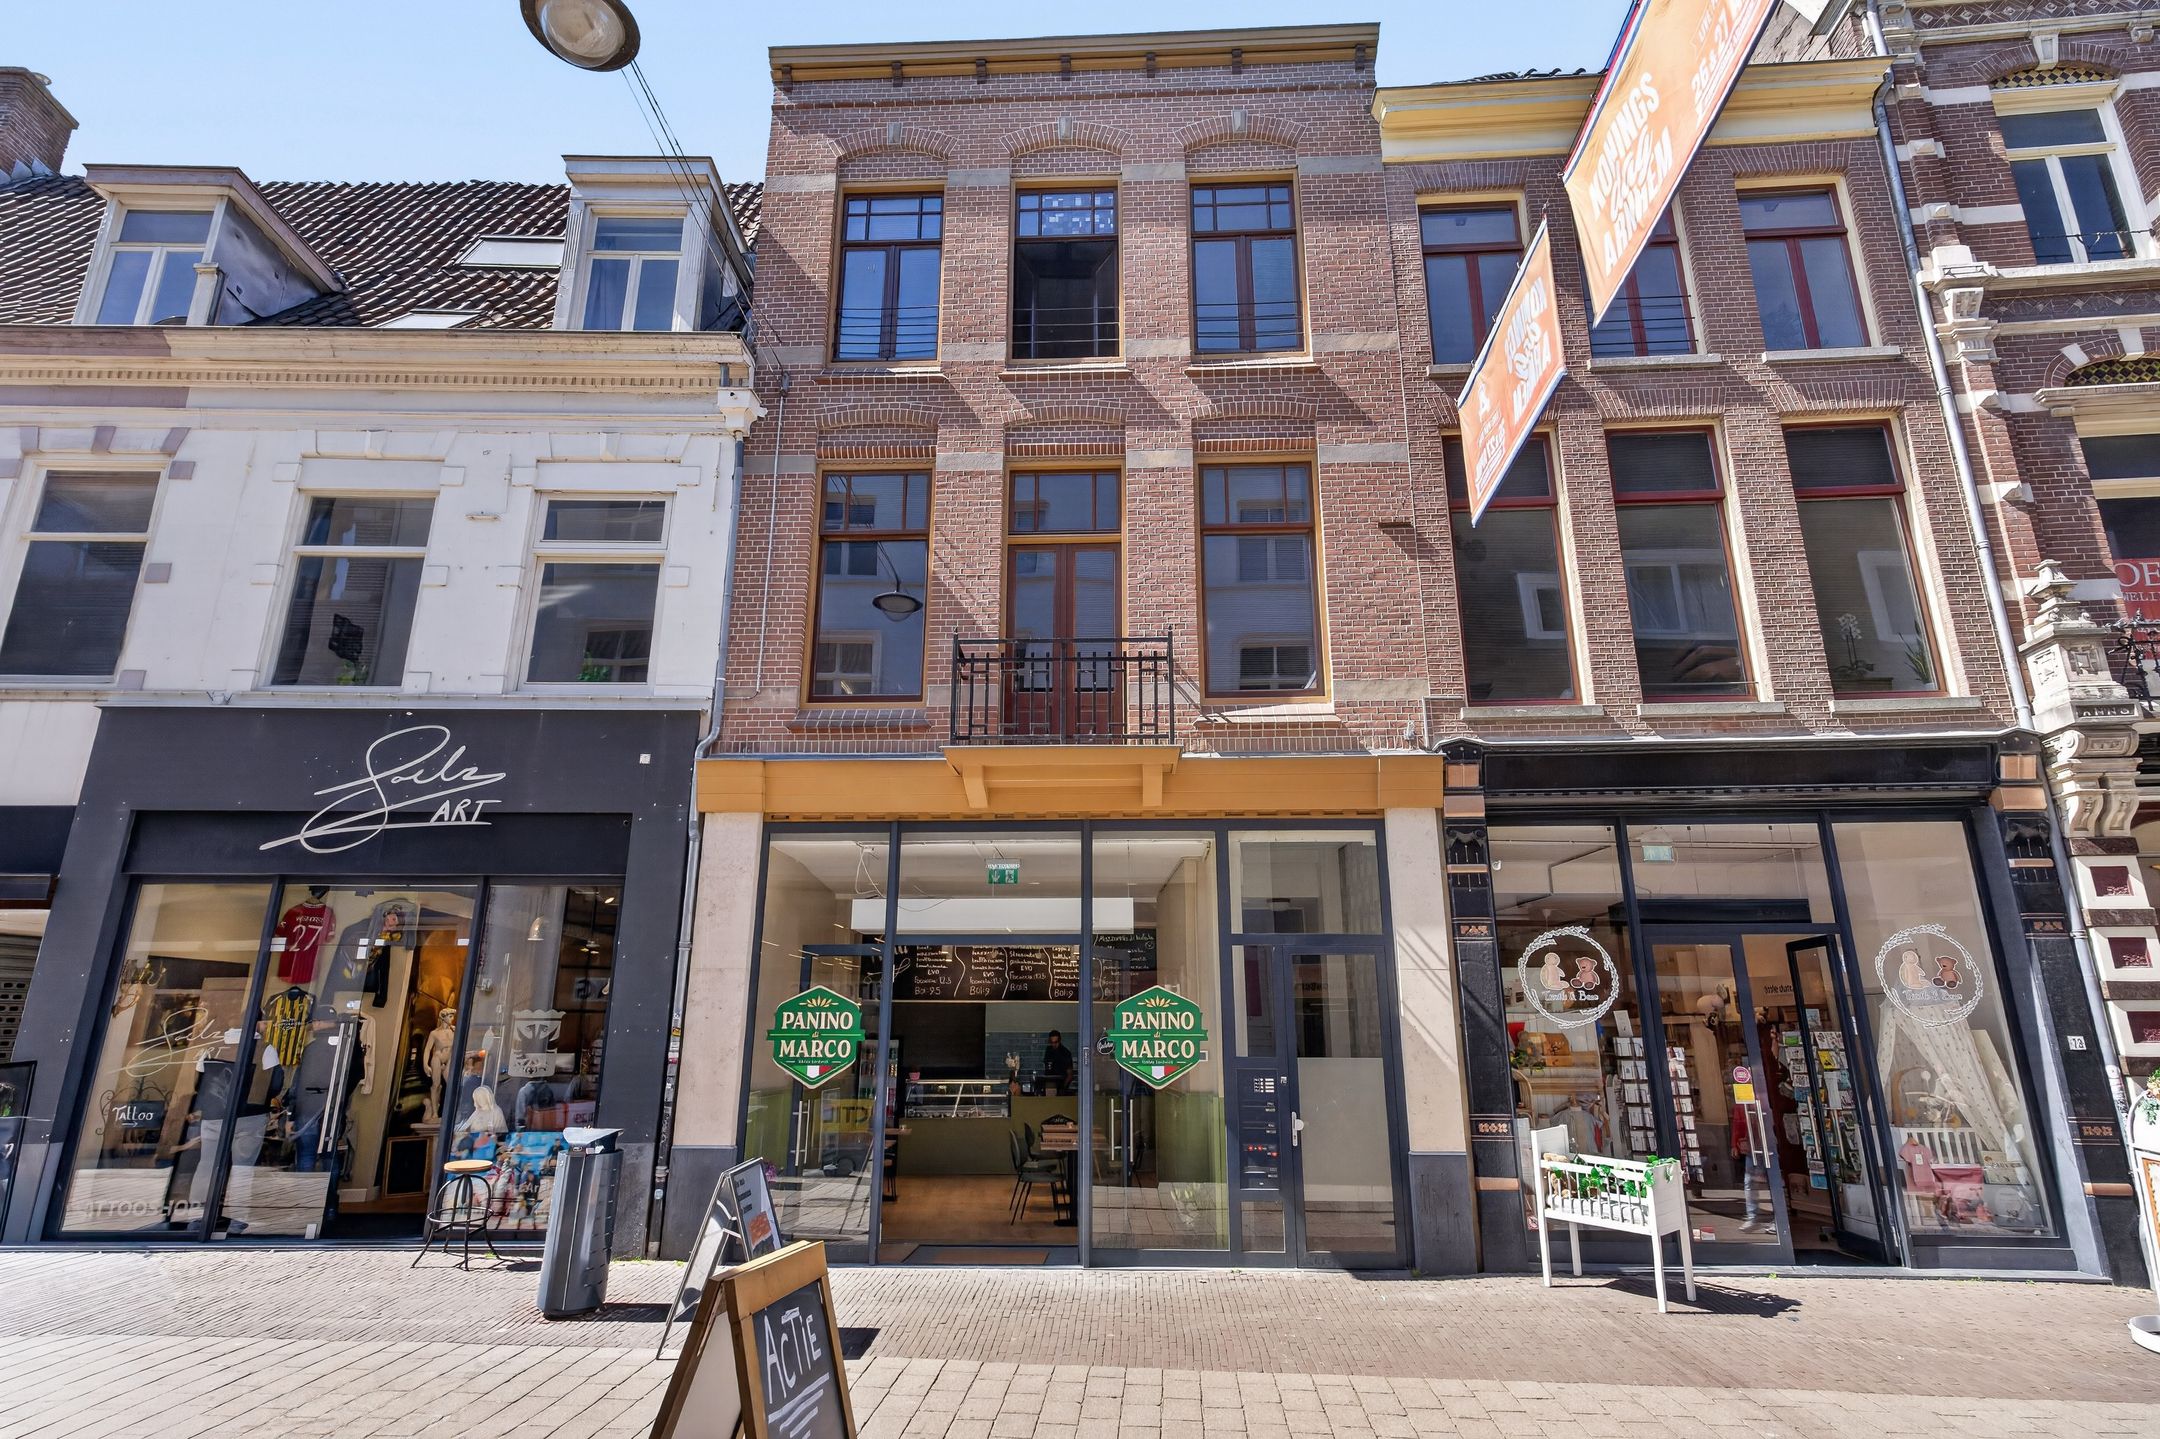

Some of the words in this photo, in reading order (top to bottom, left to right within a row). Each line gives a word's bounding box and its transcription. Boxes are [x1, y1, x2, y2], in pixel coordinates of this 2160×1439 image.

[1692, 57, 1709, 98] 26
[1714, 8, 1728, 56] 27
[1588, 72, 1660, 220] KONINGS
[1603, 126, 1674, 278] ARNHEM
[429, 798, 502, 824] ART
[289, 924, 324, 952] 27
[781, 1011, 854, 1030] PANINO
[1121, 1011, 1195, 1030] PANINO
[779, 1039, 851, 1058] MARCO
[1121, 1039, 1195, 1059] MARCO
